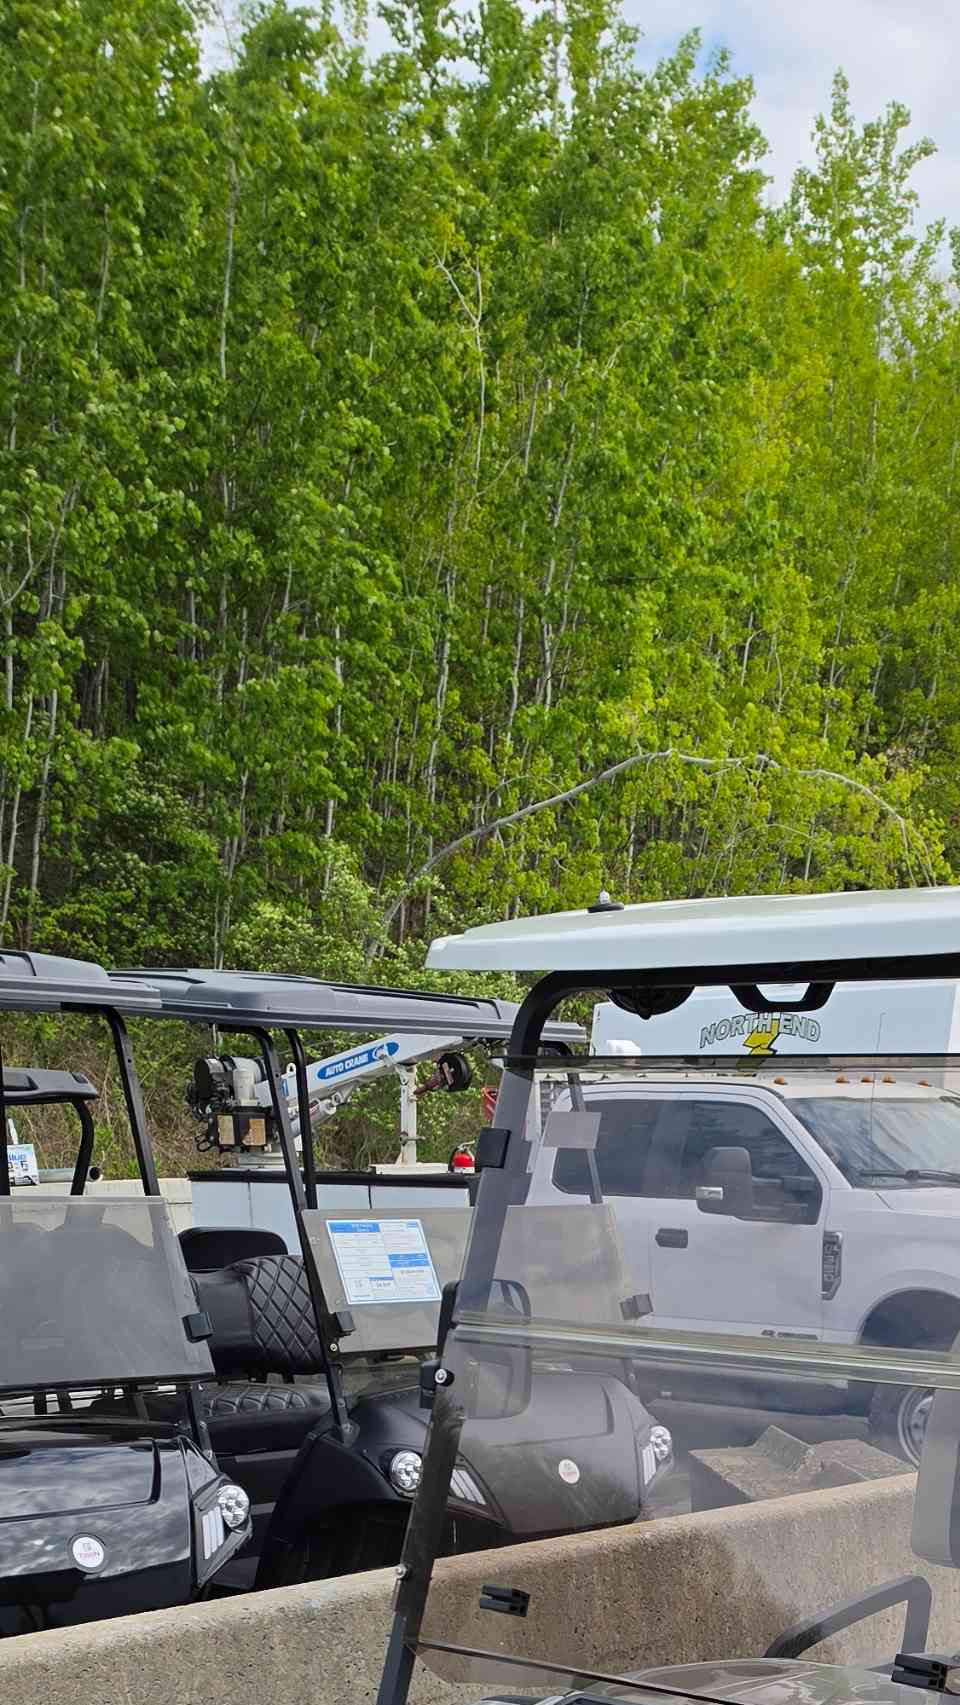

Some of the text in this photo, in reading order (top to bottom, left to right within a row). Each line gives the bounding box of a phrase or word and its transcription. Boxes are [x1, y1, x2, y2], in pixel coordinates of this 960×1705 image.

[699, 1011, 821, 1049] NORTH END
[324, 1052, 369, 1078] AUTO CRANE
